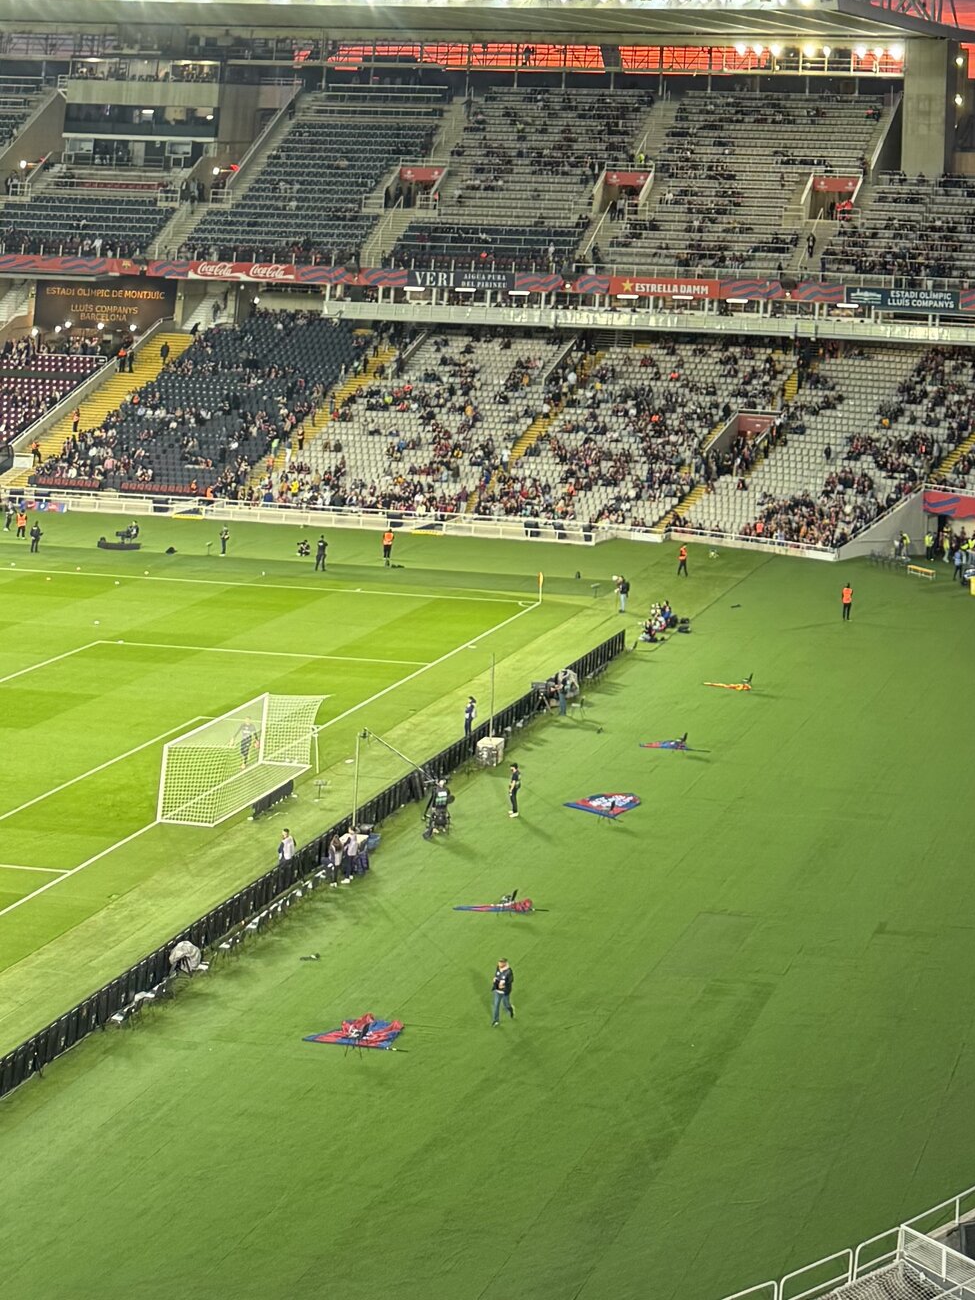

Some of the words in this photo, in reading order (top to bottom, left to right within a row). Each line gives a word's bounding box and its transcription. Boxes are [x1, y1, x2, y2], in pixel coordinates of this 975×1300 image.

[415, 271, 455, 287] VERI
[46, 287, 75, 296] ESTADI
[112, 290, 123, 298] DE
[635, 283, 679, 293] ESTRELLA
[680, 285, 709, 294] DAMM
[890, 290, 918, 298] ESTADI
[919, 290, 952, 300] OLÍMPIC
[887, 298, 910, 306] LLUÍS
[911, 300, 954, 309] COMPANYS
[95, 304, 138, 315] COMPANYS
[80, 312, 127, 322] BARCELONA
